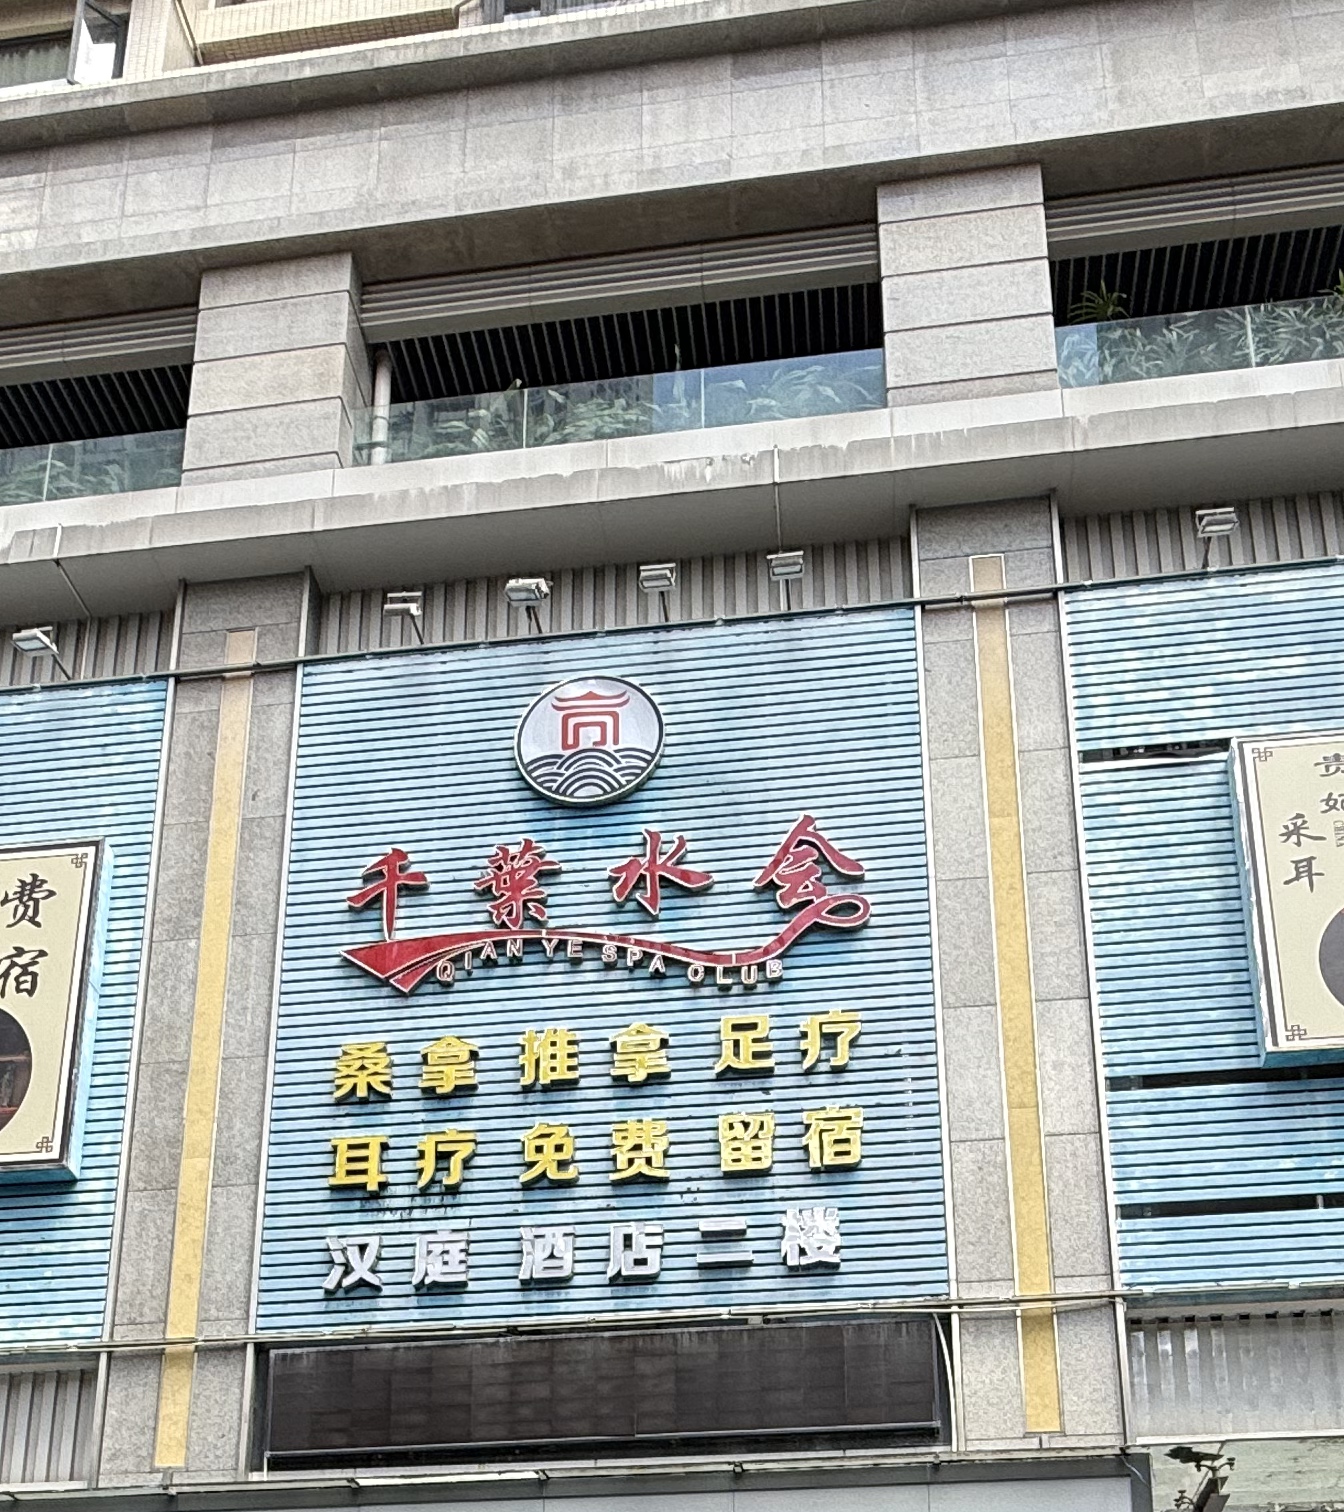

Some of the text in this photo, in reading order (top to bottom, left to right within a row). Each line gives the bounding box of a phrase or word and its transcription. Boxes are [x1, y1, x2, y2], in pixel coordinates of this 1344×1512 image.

[1278, 812, 1327, 893] 采耳
[436, 938, 785, 985] QIAN YE SPA CLUB
